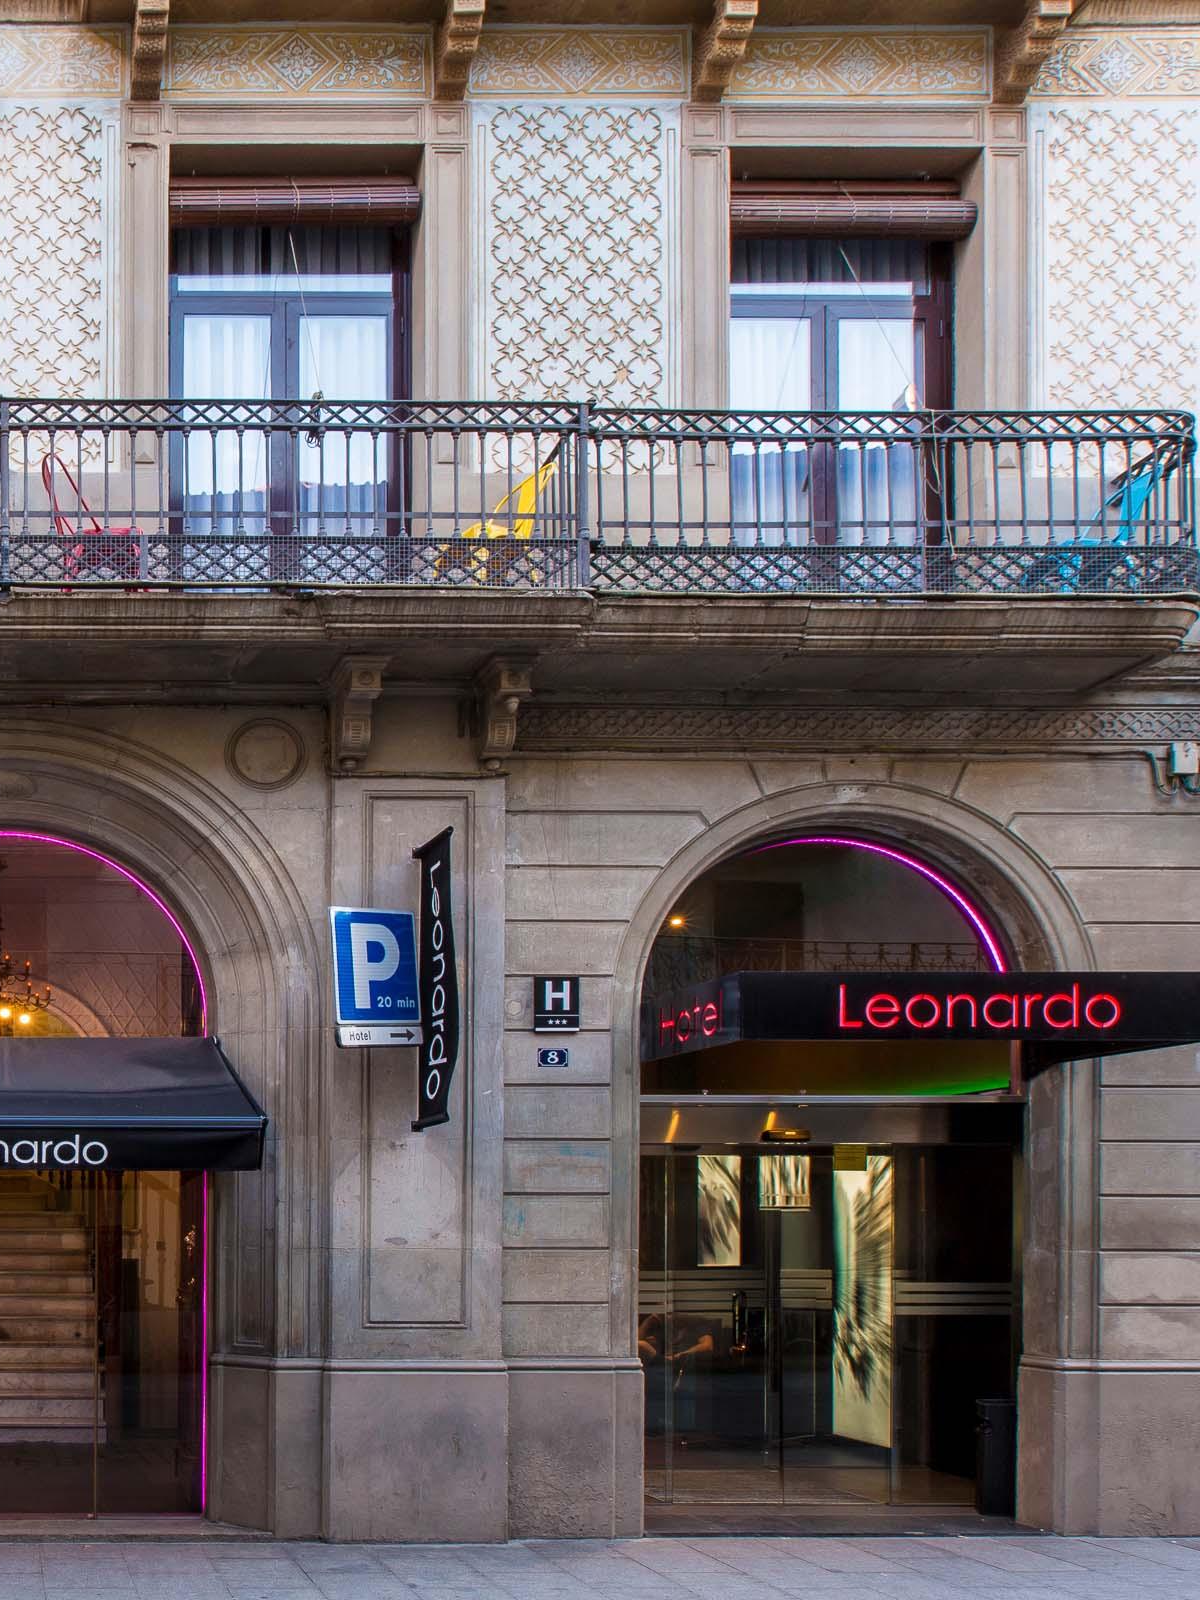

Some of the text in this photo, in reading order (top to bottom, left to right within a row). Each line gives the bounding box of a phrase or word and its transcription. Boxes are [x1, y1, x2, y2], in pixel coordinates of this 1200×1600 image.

[349, 922, 400, 1010] P
[426, 860, 449, 1101] Leonardo
[376, 996, 417, 1009] 20 min
[544, 980, 571, 1011] H
[838, 982, 1122, 1029] Leonardo
[348, 1031, 372, 1042] Hotel
[659, 989, 724, 1048] Hotel
[546, 1050, 560, 1065] 8
